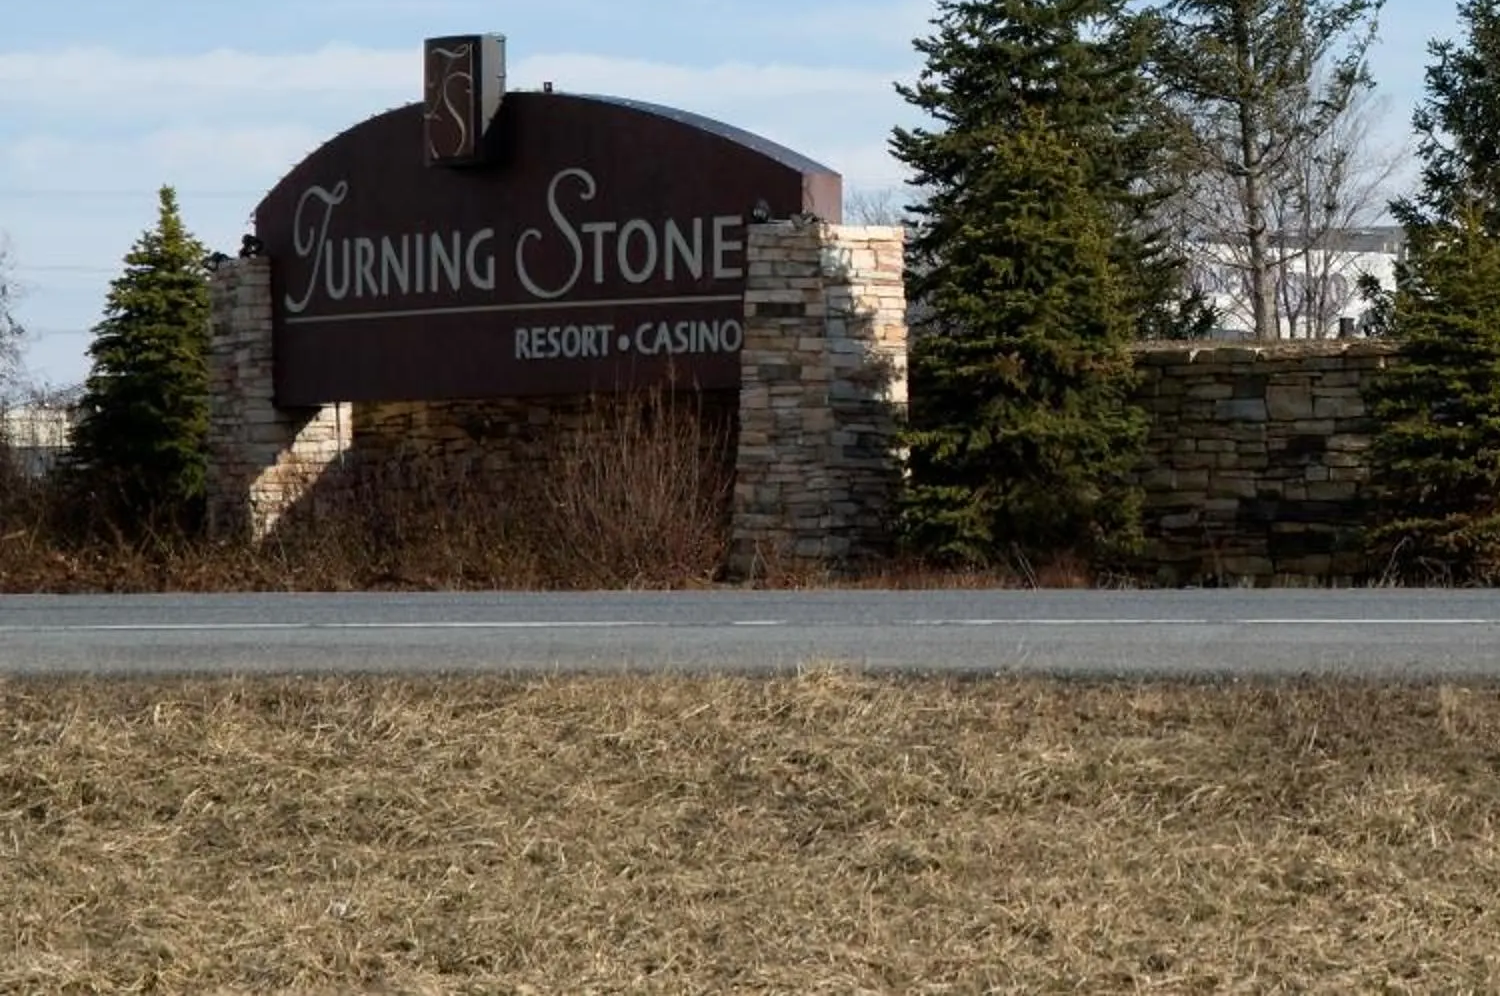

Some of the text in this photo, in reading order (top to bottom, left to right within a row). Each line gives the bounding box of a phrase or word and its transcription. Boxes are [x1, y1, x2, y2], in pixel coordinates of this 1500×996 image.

[284, 167, 743, 313] TURNING STONE
[514, 318, 743, 360] RESORT CASINO
